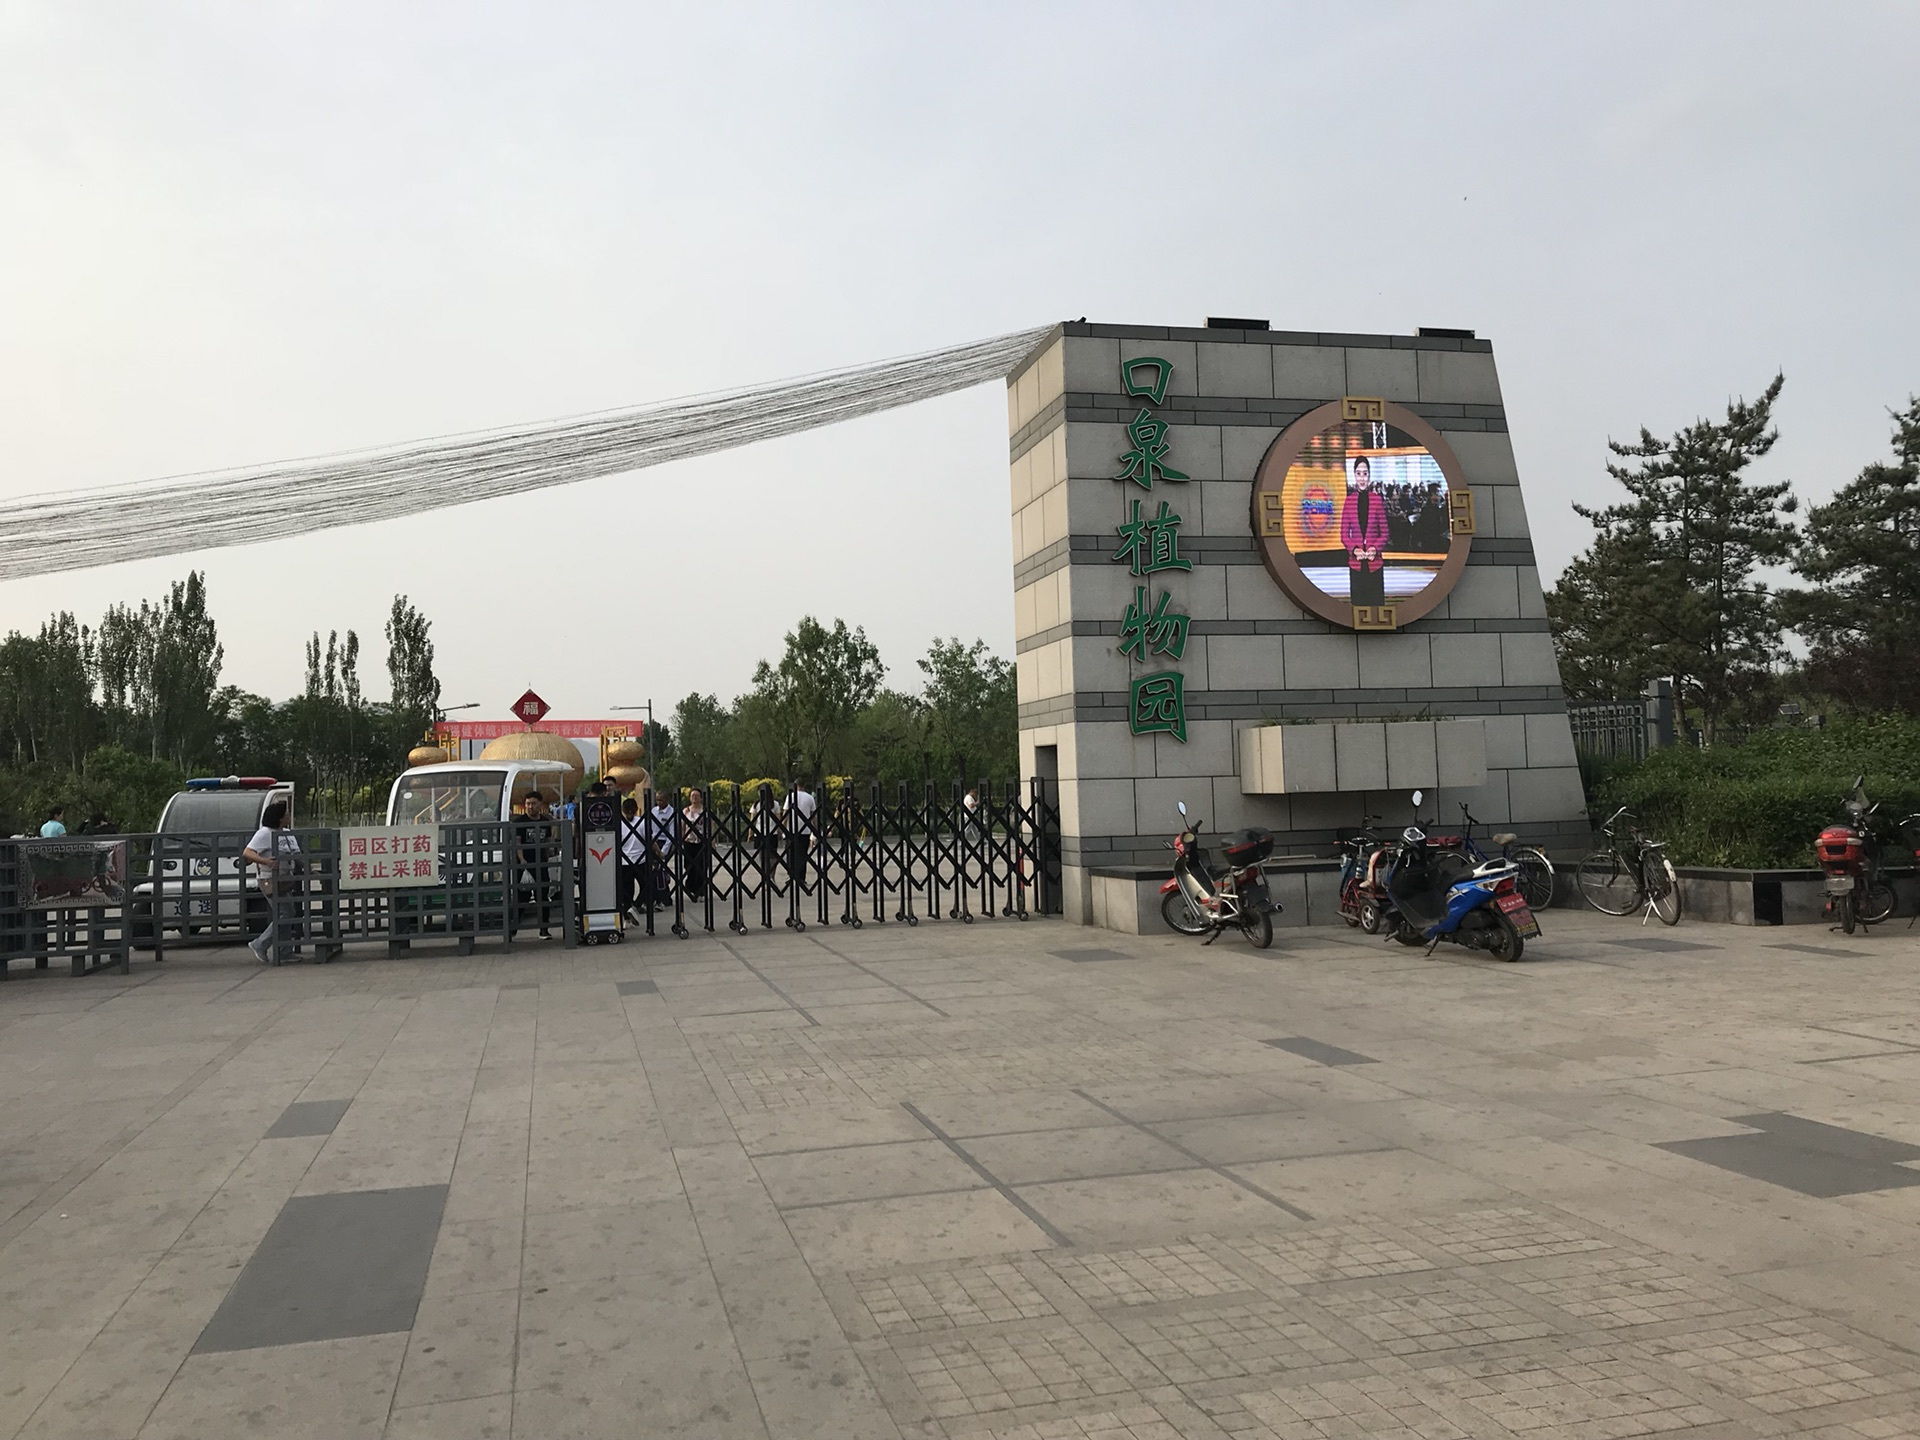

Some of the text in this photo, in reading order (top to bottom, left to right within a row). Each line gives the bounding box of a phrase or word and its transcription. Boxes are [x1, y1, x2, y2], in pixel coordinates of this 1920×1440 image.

[1113, 356, 1193, 744] 口泉植物园
[522, 701, 539, 716] 福
[349, 834, 431, 856] 园区打药
[349, 859, 432, 880] 禁止采摘
